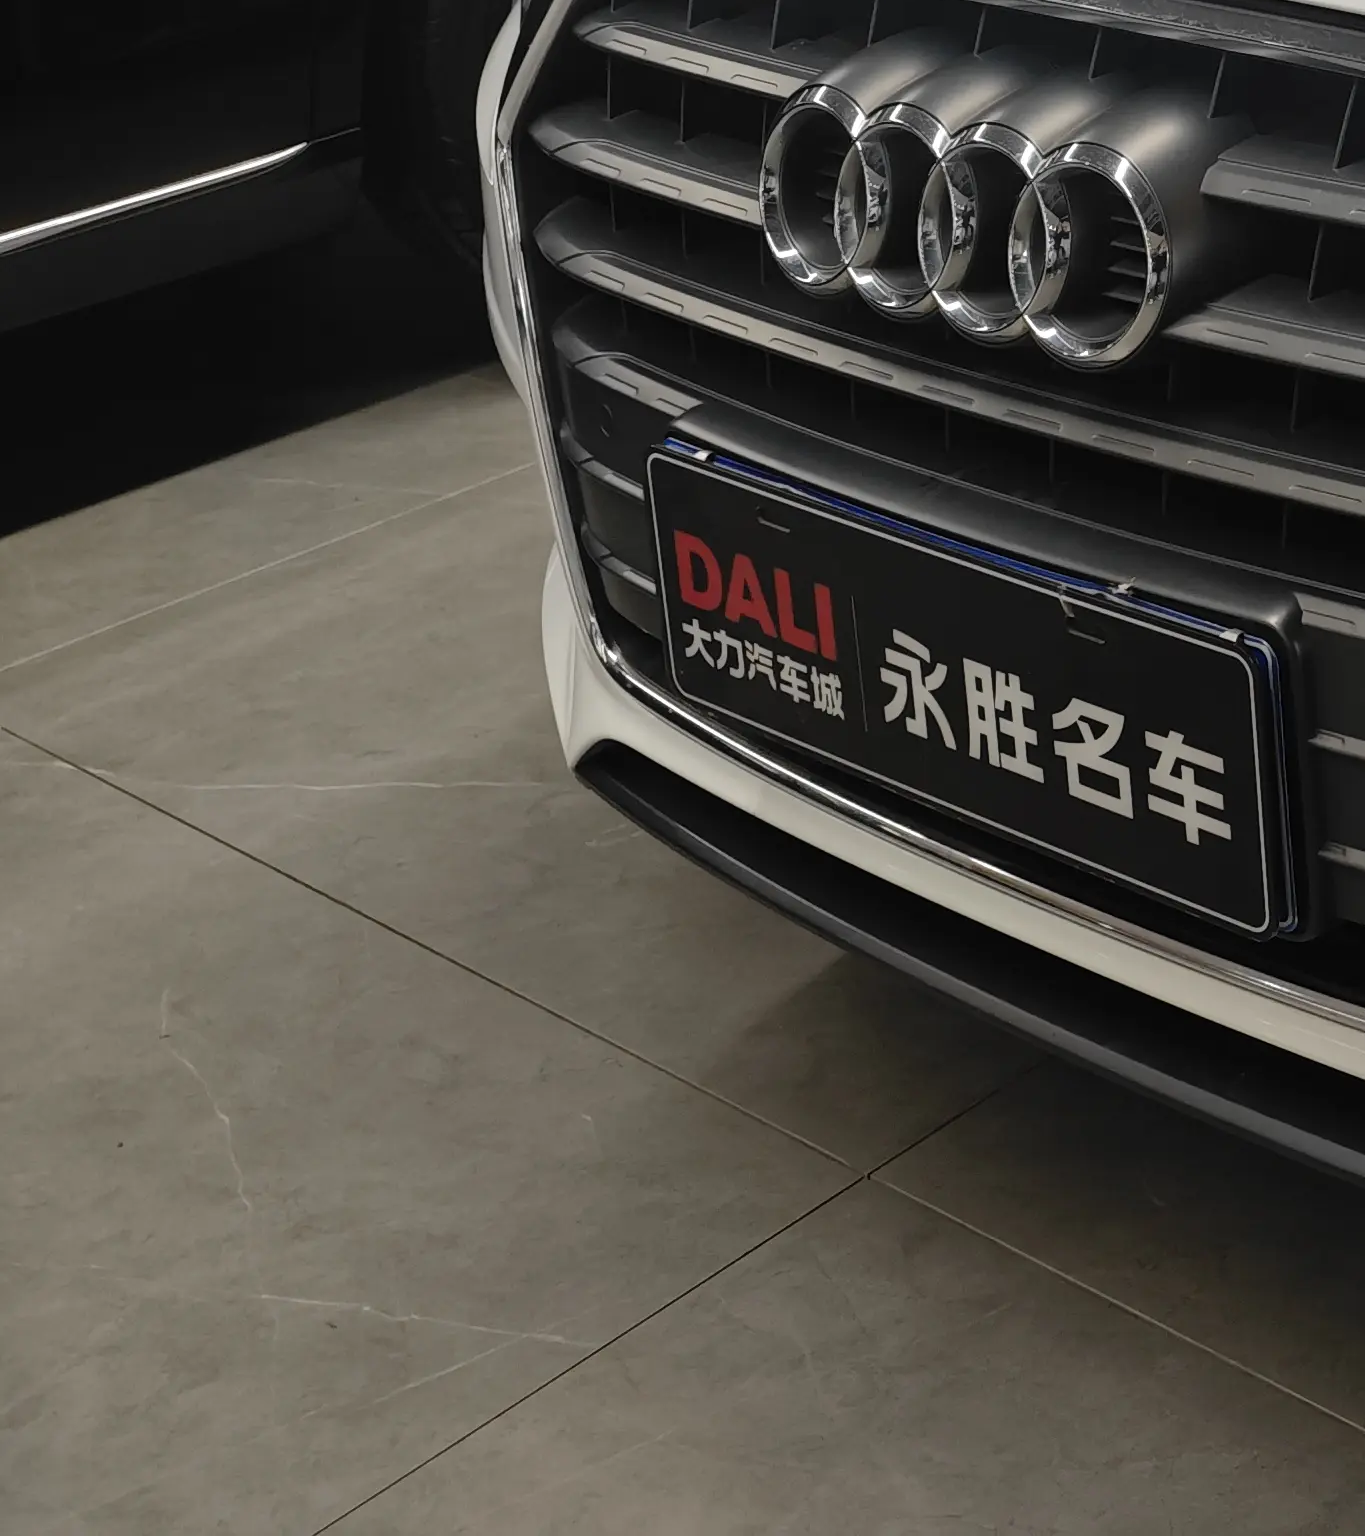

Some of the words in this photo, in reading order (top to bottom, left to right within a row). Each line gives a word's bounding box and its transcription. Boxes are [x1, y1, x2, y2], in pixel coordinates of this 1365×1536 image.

[674, 528, 837, 662] DALI
[681, 618, 846, 721] 大力汽车城
[880, 628, 1232, 846] 永胜名车
